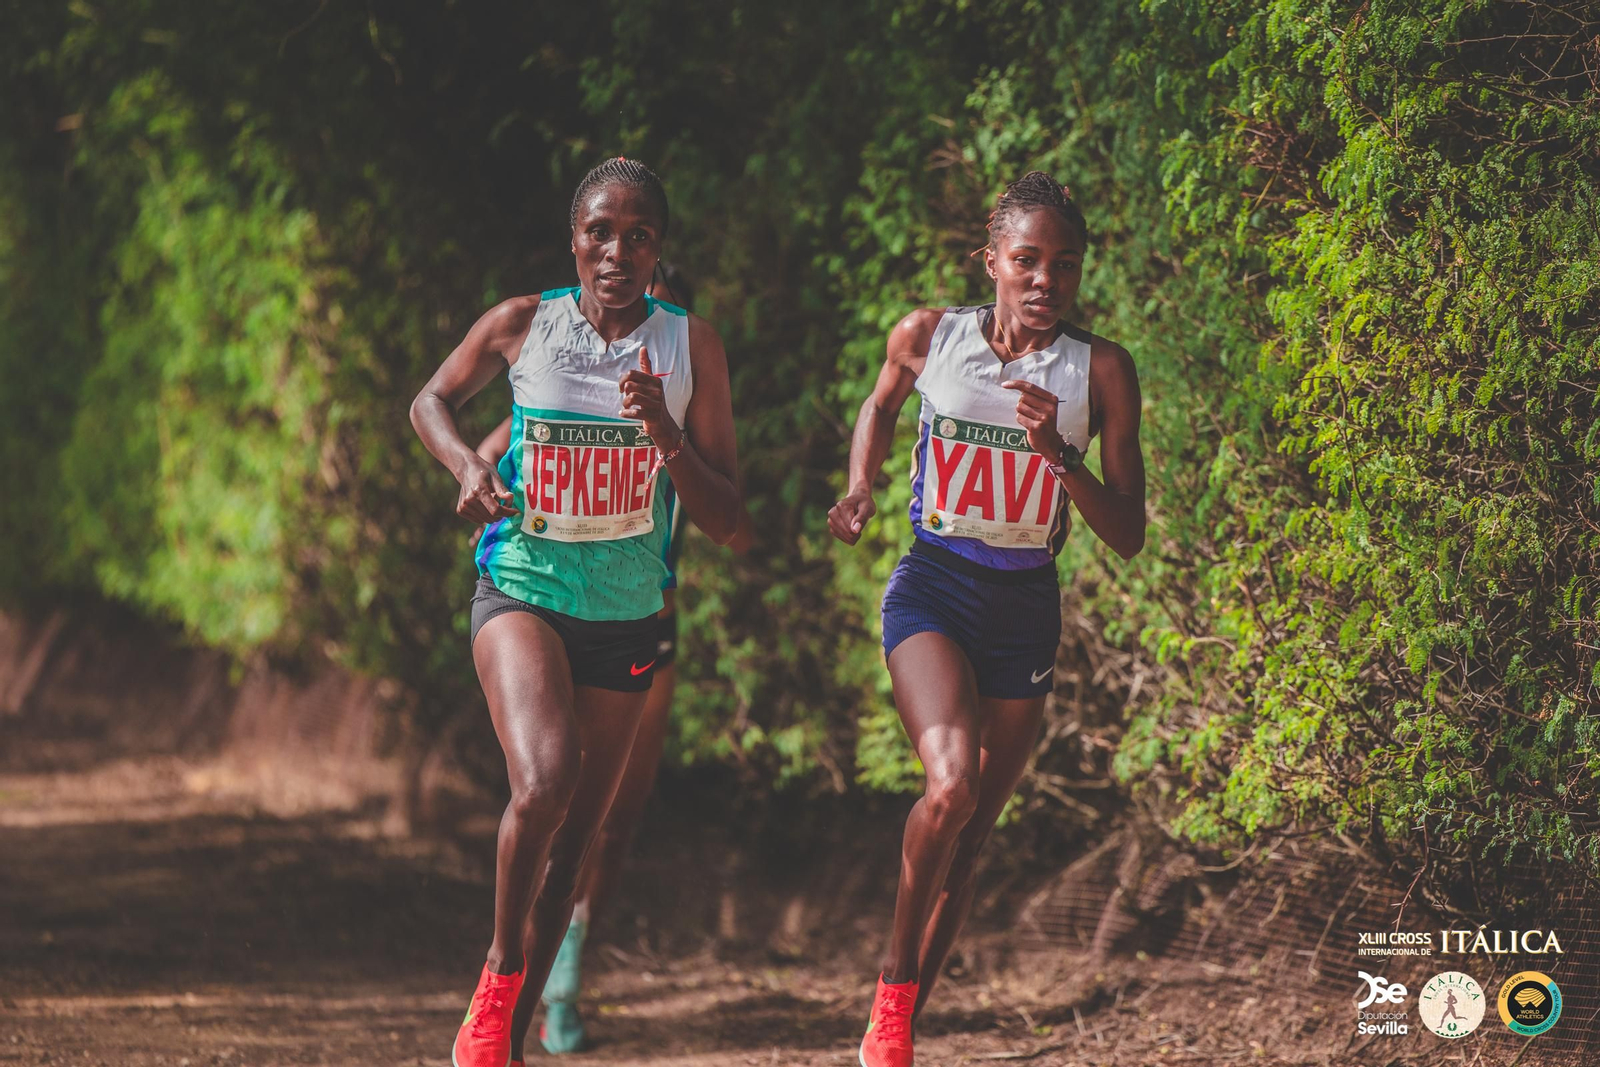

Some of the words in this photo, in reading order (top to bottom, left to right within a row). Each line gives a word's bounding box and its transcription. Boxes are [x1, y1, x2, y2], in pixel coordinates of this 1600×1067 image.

[560, 426, 624, 443] ITÁLICA
[965, 426, 1028, 448] ITÁLICA
[526, 443, 656, 516] JEPKEMEI
[932, 437, 1056, 525] YAVI
